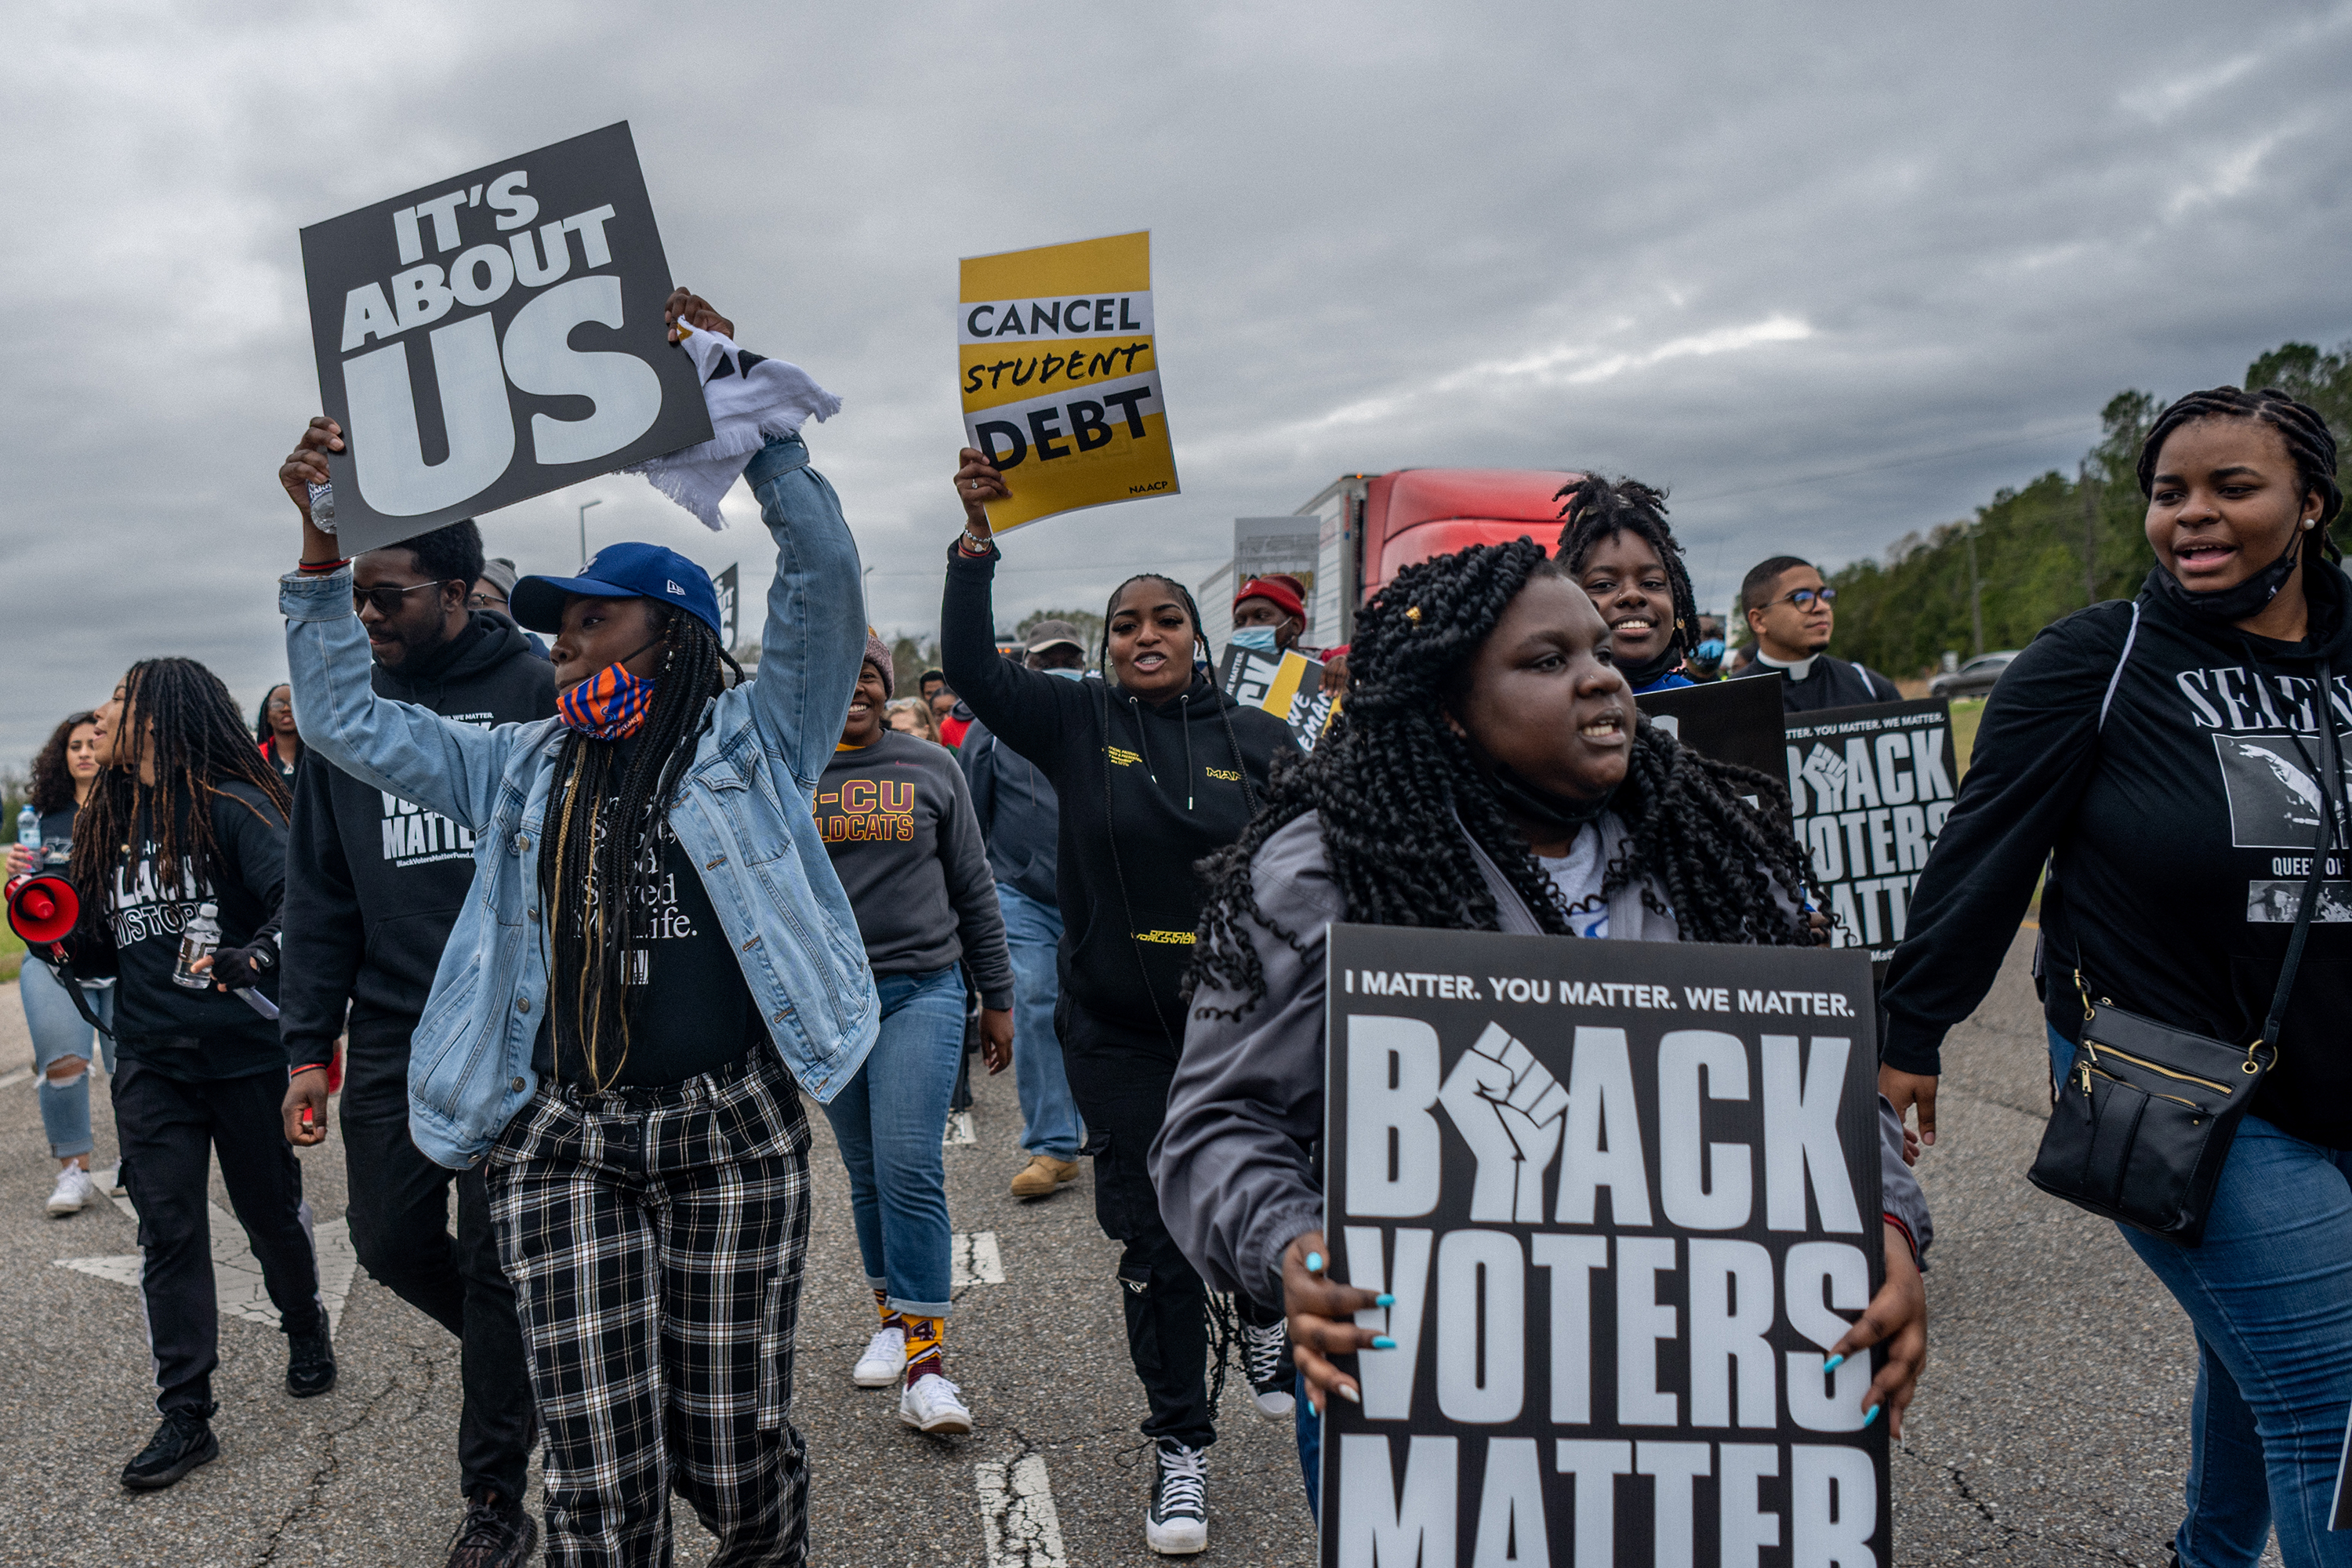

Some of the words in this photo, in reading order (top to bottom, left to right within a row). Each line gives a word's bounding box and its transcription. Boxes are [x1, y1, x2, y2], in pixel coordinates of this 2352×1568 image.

[394, 170, 539, 266] IT'S
[340, 204, 615, 353] ABOUT
[967, 297, 1141, 338] CANCEL
[964, 343, 1149, 394] STUDENT
[342, 275, 662, 517] US
[975, 385, 1152, 472] DEBT
[1129, 481, 1168, 495] NAACP
[465, 711, 495, 720] MATTER.
[1286, 691, 1311, 728] WE
[1296, 689, 1331, 753] EMAN
[1785, 726, 1813, 740] TTER.
[1813, 724, 1838, 736] YOU
[1838, 719, 1882, 734] MATTER.
[1882, 717, 1900, 729] WE
[1901, 712, 1945, 727] MATTER.
[382, 812, 478, 860] MATTE
[814, 813, 915, 844] LDCATS
[1793, 800, 1957, 883] OTERS
[2272, 856, 2314, 877] QUEE
[1345, 968, 1354, 994] I
[1361, 971, 1482, 1000] MATTER.
[1490, 977, 1551, 1004] YOU
[1559, 981, 1677, 1011] MATTER.
[1684, 986, 1730, 1012] WE
[1737, 989, 1856, 1018] MATTER.
[1344, 1225, 1873, 1433] VOTERS
[1338, 1433, 1878, 1568] MATTER
